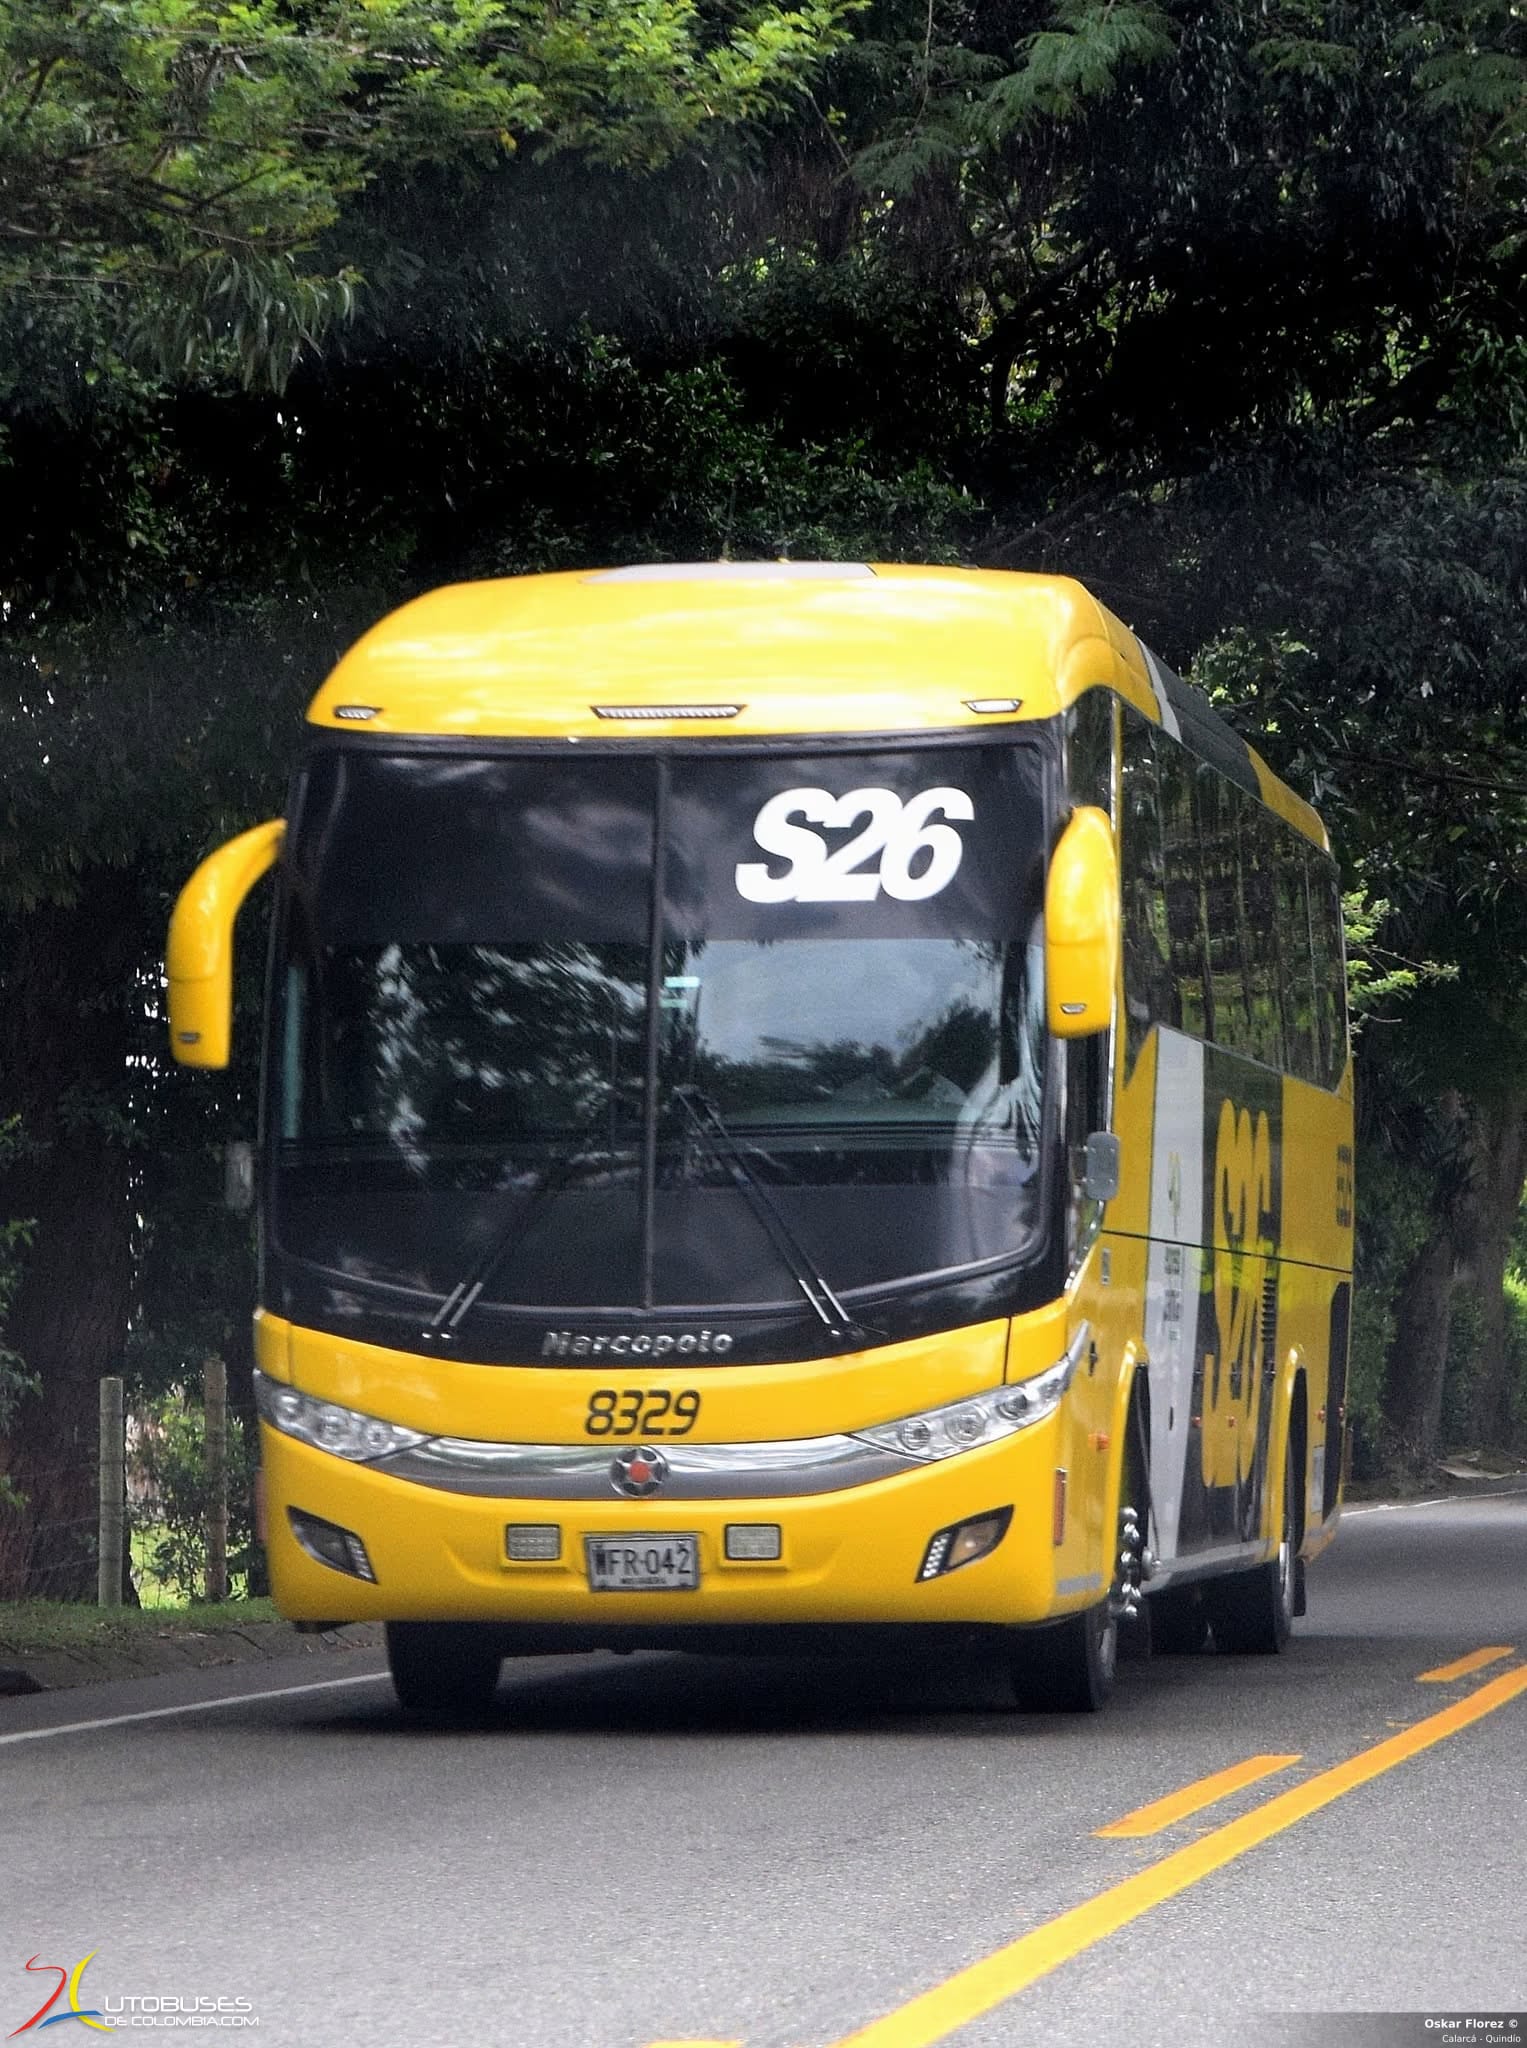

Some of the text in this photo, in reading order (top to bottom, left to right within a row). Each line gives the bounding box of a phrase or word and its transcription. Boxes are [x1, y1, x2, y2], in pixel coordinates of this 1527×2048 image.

[735, 787, 975, 904] S26
[1201, 1098, 1271, 1489] S26
[541, 1330, 734, 1358] Marcopolo
[585, 1389, 701, 1436] 8329
